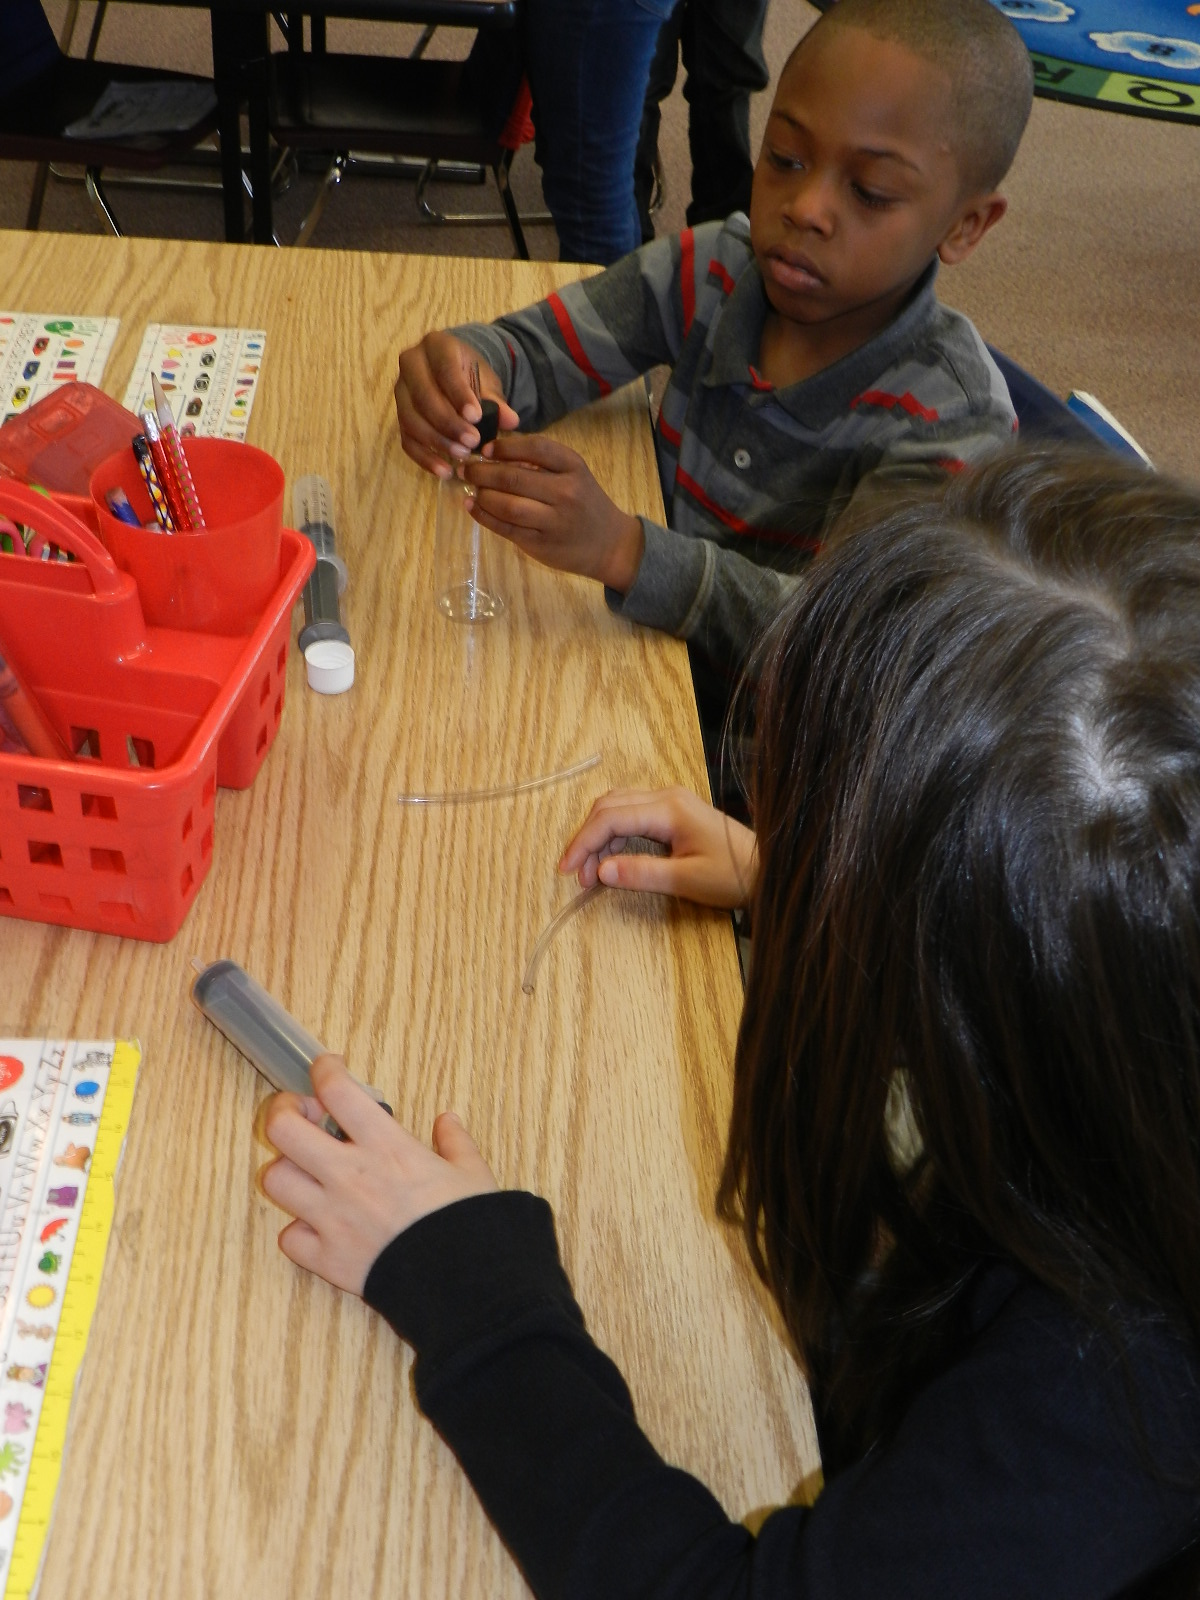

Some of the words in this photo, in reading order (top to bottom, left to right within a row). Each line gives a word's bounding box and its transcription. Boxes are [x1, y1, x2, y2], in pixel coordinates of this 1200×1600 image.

[1127, 80, 1195, 107] Q
[39, 1048, 66, 1071] Zz
[31, 1073, 69, 1100] Yy
[12, 1138, 44, 1178] Ww
[6, 1182, 33, 1209] Vv
